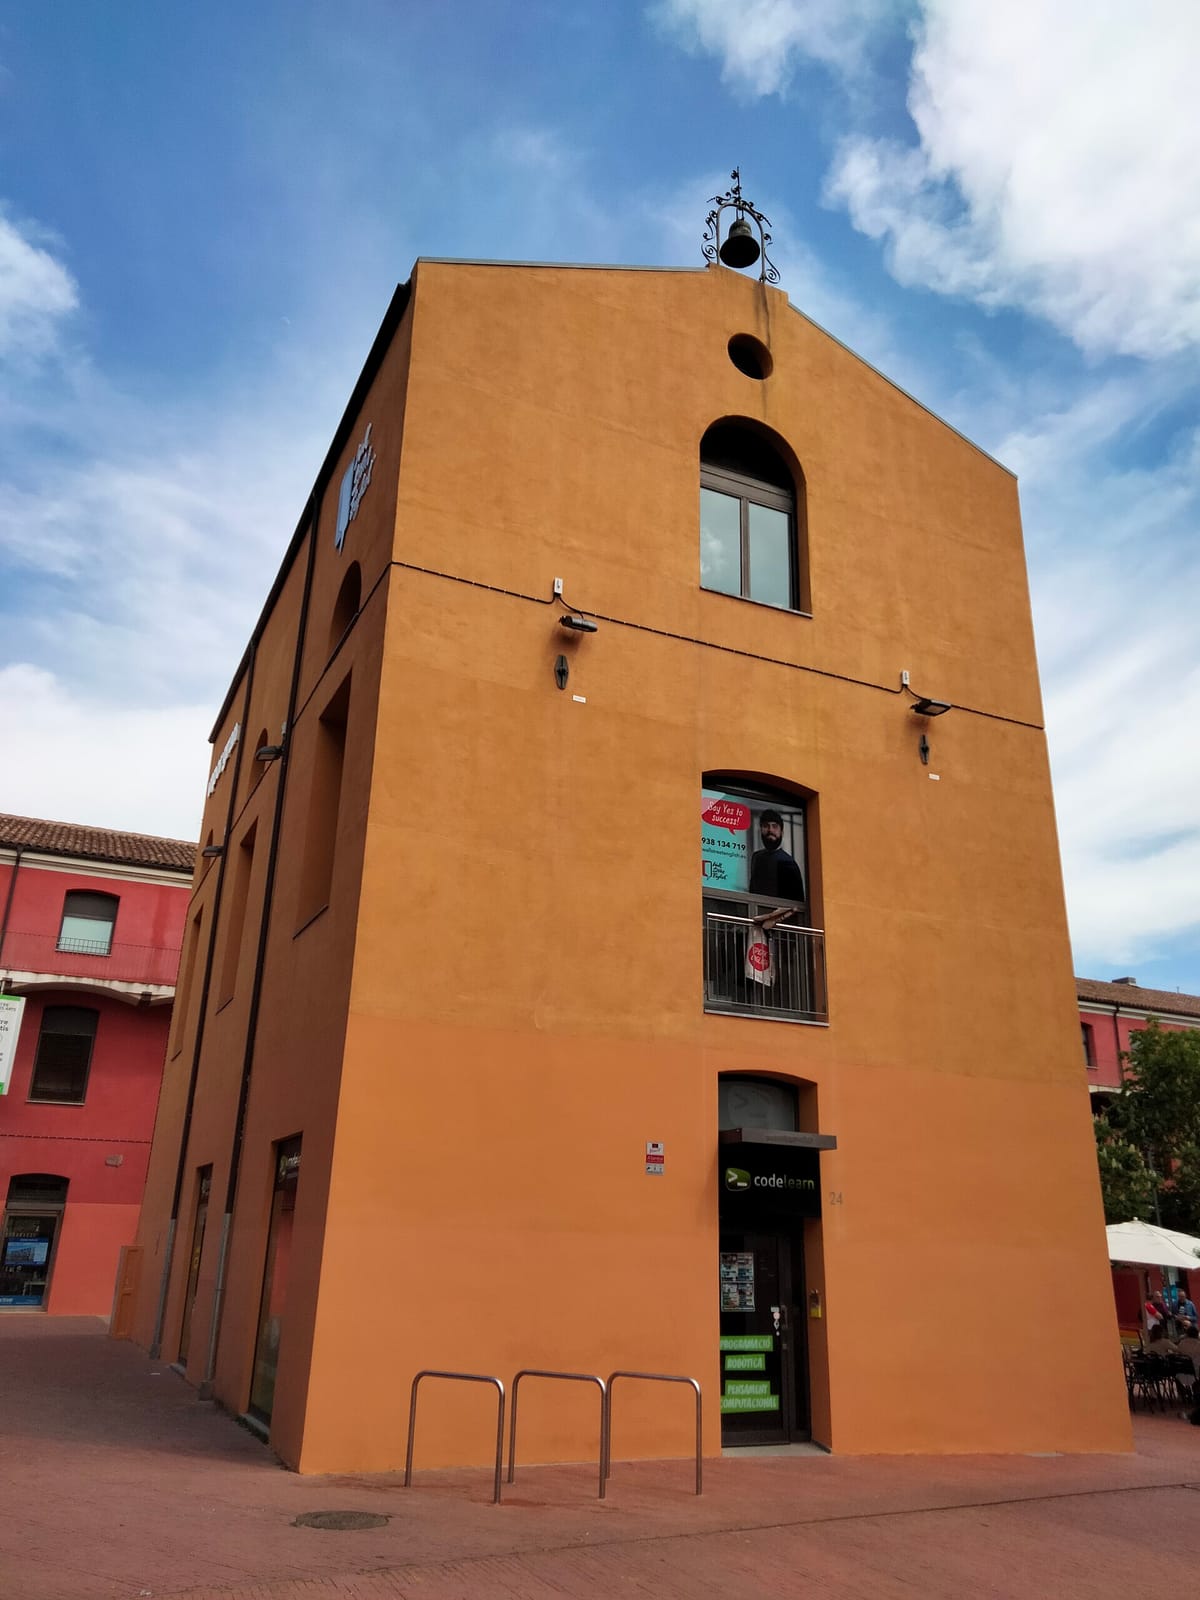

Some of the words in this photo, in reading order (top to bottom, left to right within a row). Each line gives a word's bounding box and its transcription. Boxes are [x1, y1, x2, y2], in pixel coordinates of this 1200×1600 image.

[707, 800, 721, 815] Say
[723, 803, 734, 815] Yes
[736, 808, 743, 817] to
[711, 814, 740, 826] success!
[701, 837, 715, 846] 938
[717, 840, 731, 848] 134
[731, 842, 746, 851] 719
[754, 1173, 815, 1190] codelearn
[829, 1191, 843, 1205] 24
